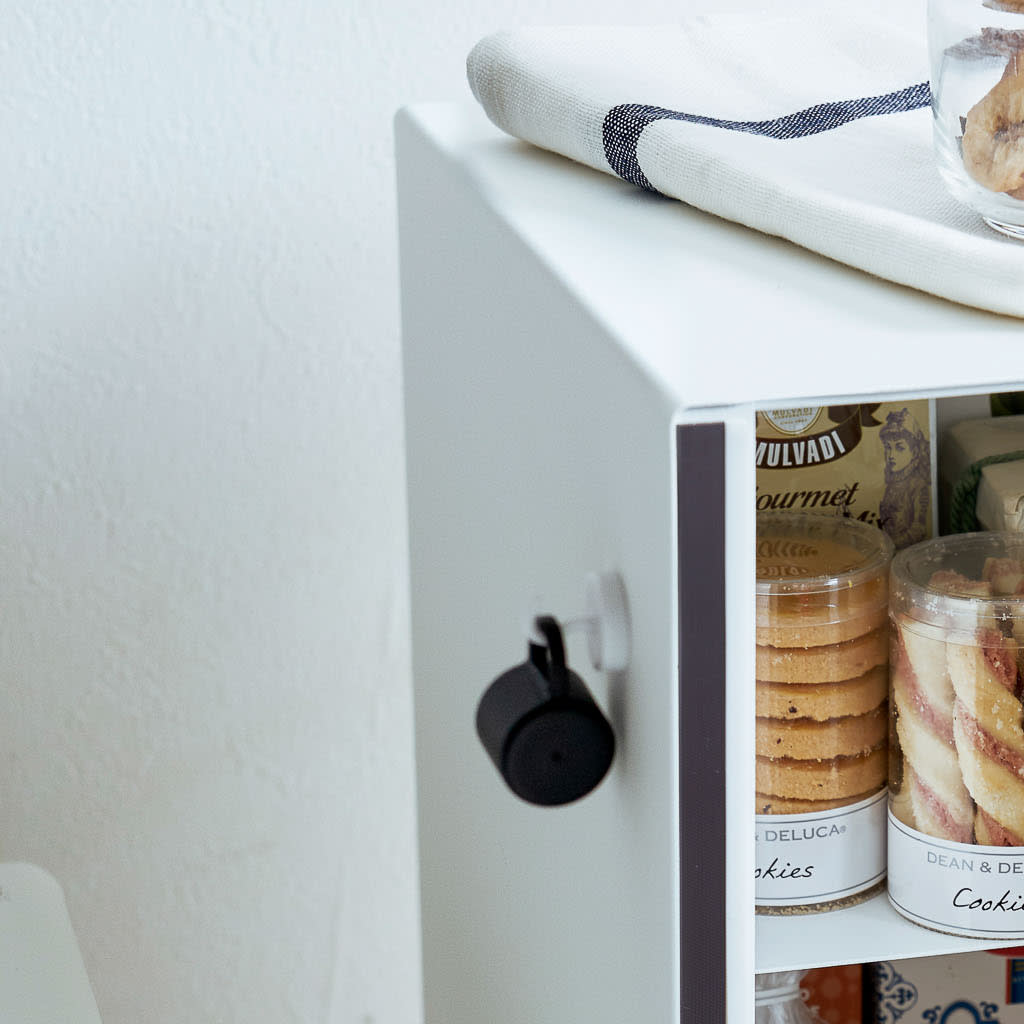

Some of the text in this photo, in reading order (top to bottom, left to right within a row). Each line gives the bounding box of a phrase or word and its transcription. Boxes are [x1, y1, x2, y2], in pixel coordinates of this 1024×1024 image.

[756, 482, 859, 511] ourmet
[755, 857, 814, 879] okies
[927, 851, 974, 872] DEAN
[979, 861, 992, 873] &
